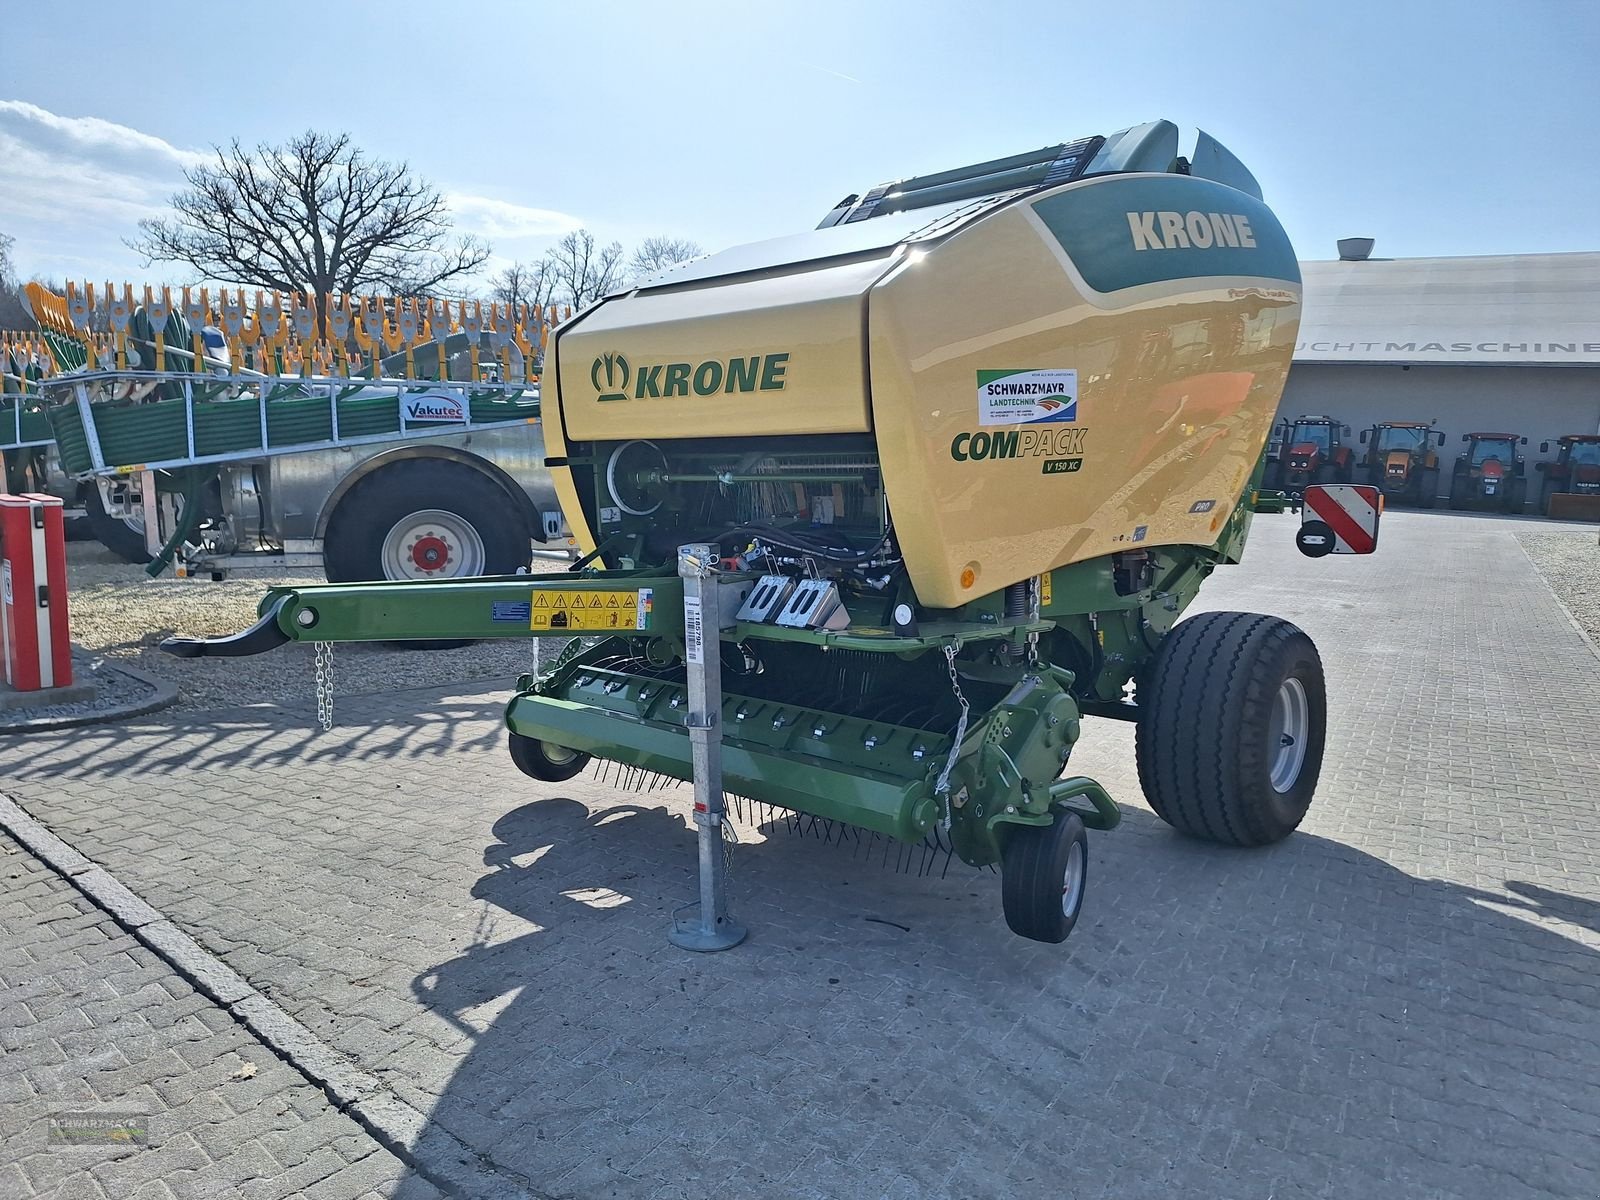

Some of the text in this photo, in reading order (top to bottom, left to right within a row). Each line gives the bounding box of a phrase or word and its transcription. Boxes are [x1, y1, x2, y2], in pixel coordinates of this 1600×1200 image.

[1126, 210, 1257, 251] KRONE
[635, 352, 790, 399] KRONE
[987, 382, 1065, 396] SCHWARZMAYR
[407, 402, 464, 418] Vakutec
[989, 398, 1036, 407] LANDTECHNIK
[950, 428, 1089, 462] COMPACK
[1047, 461, 1079, 471] V 150 XC
